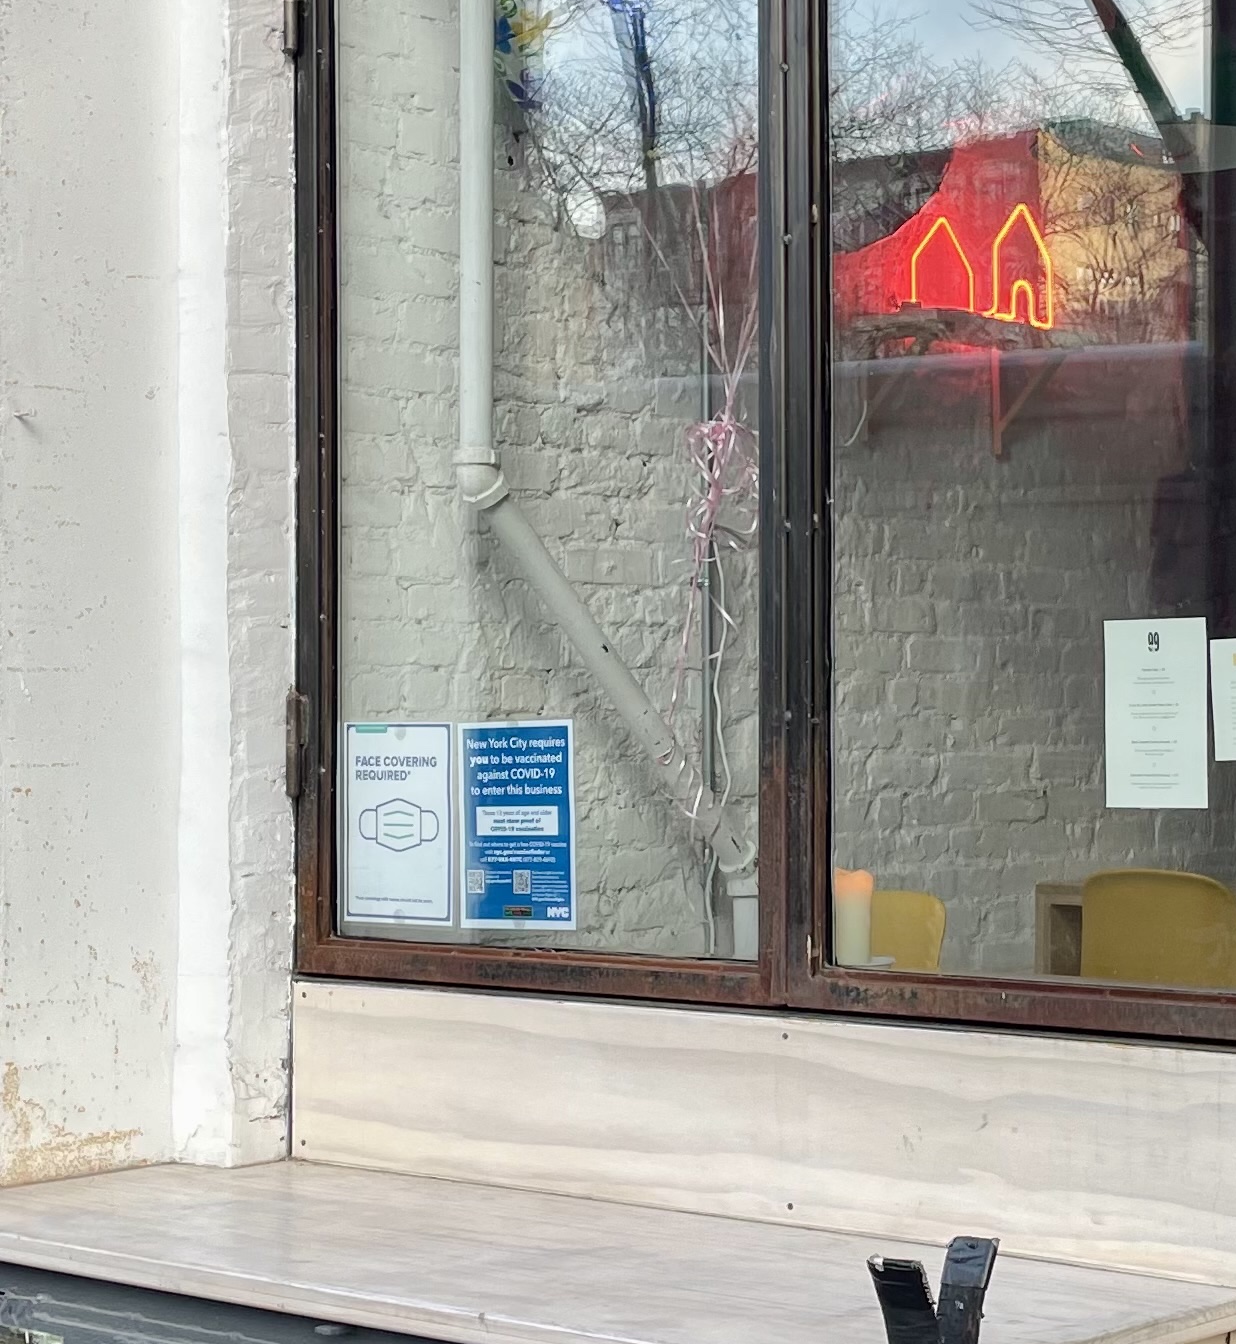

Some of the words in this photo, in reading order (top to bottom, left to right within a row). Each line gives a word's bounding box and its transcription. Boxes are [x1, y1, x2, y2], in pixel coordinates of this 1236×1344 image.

[466, 738, 487, 749] New
[488, 737, 508, 749] York
[509, 737, 527, 751] City
[529, 736, 566, 750] requires
[355, 756, 381, 767] FACE
[383, 756, 437, 768] COVERING
[469, 756, 489, 767] you
[490, 755, 500, 764] to
[501, 752, 513, 764] be
[514, 751, 563, 764] vaccinated
[476, 769, 509, 783] against
[510, 768, 556, 779] COVID-19
[470, 786, 480, 795] to
[482, 786, 505, 795] enter
[506, 783, 523, 795] this
[524, 782, 562, 795] business
[546, 906, 570, 918] NYC
